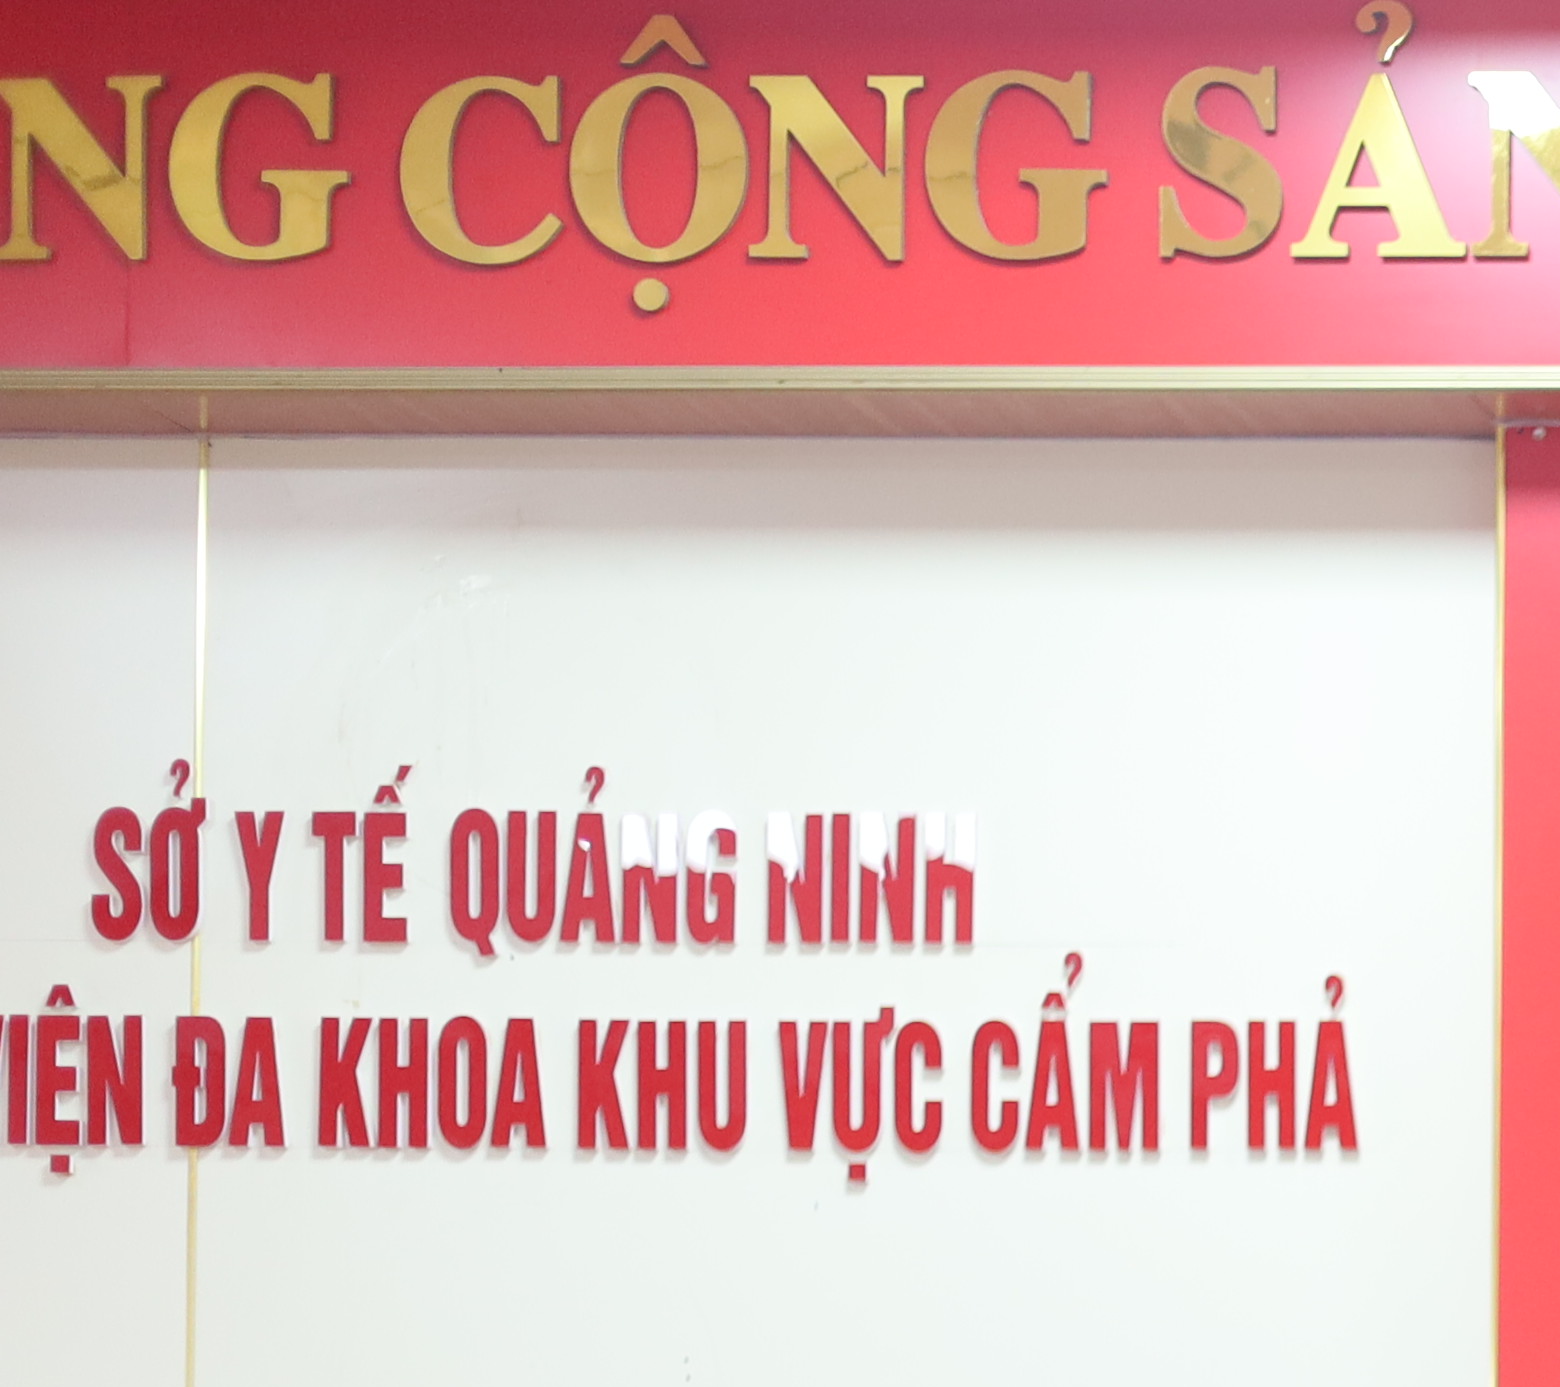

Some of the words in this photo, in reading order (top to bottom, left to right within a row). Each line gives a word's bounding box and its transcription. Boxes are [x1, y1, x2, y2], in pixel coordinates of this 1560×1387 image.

[400, 15, 1107, 311] CỘNG
[91, 759, 207, 942] SỞ
[235, 811, 286, 943] Y
[311, 764, 414, 943] TẾ
[450, 766, 738, 957] QUẢNG
[766, 811, 977, 945] NINH
[0, 984, 144, 1175] IỆN
[172, 1015, 285, 1149] ĐA
[318, 1015, 547, 1150] KHOA
[577, 1018, 748, 1153] KHU
[779, 1007, 943, 1182] VỰC
[970, 952, 1161, 1154] CẨM
[1191, 975, 1359, 1151] PHẢ
